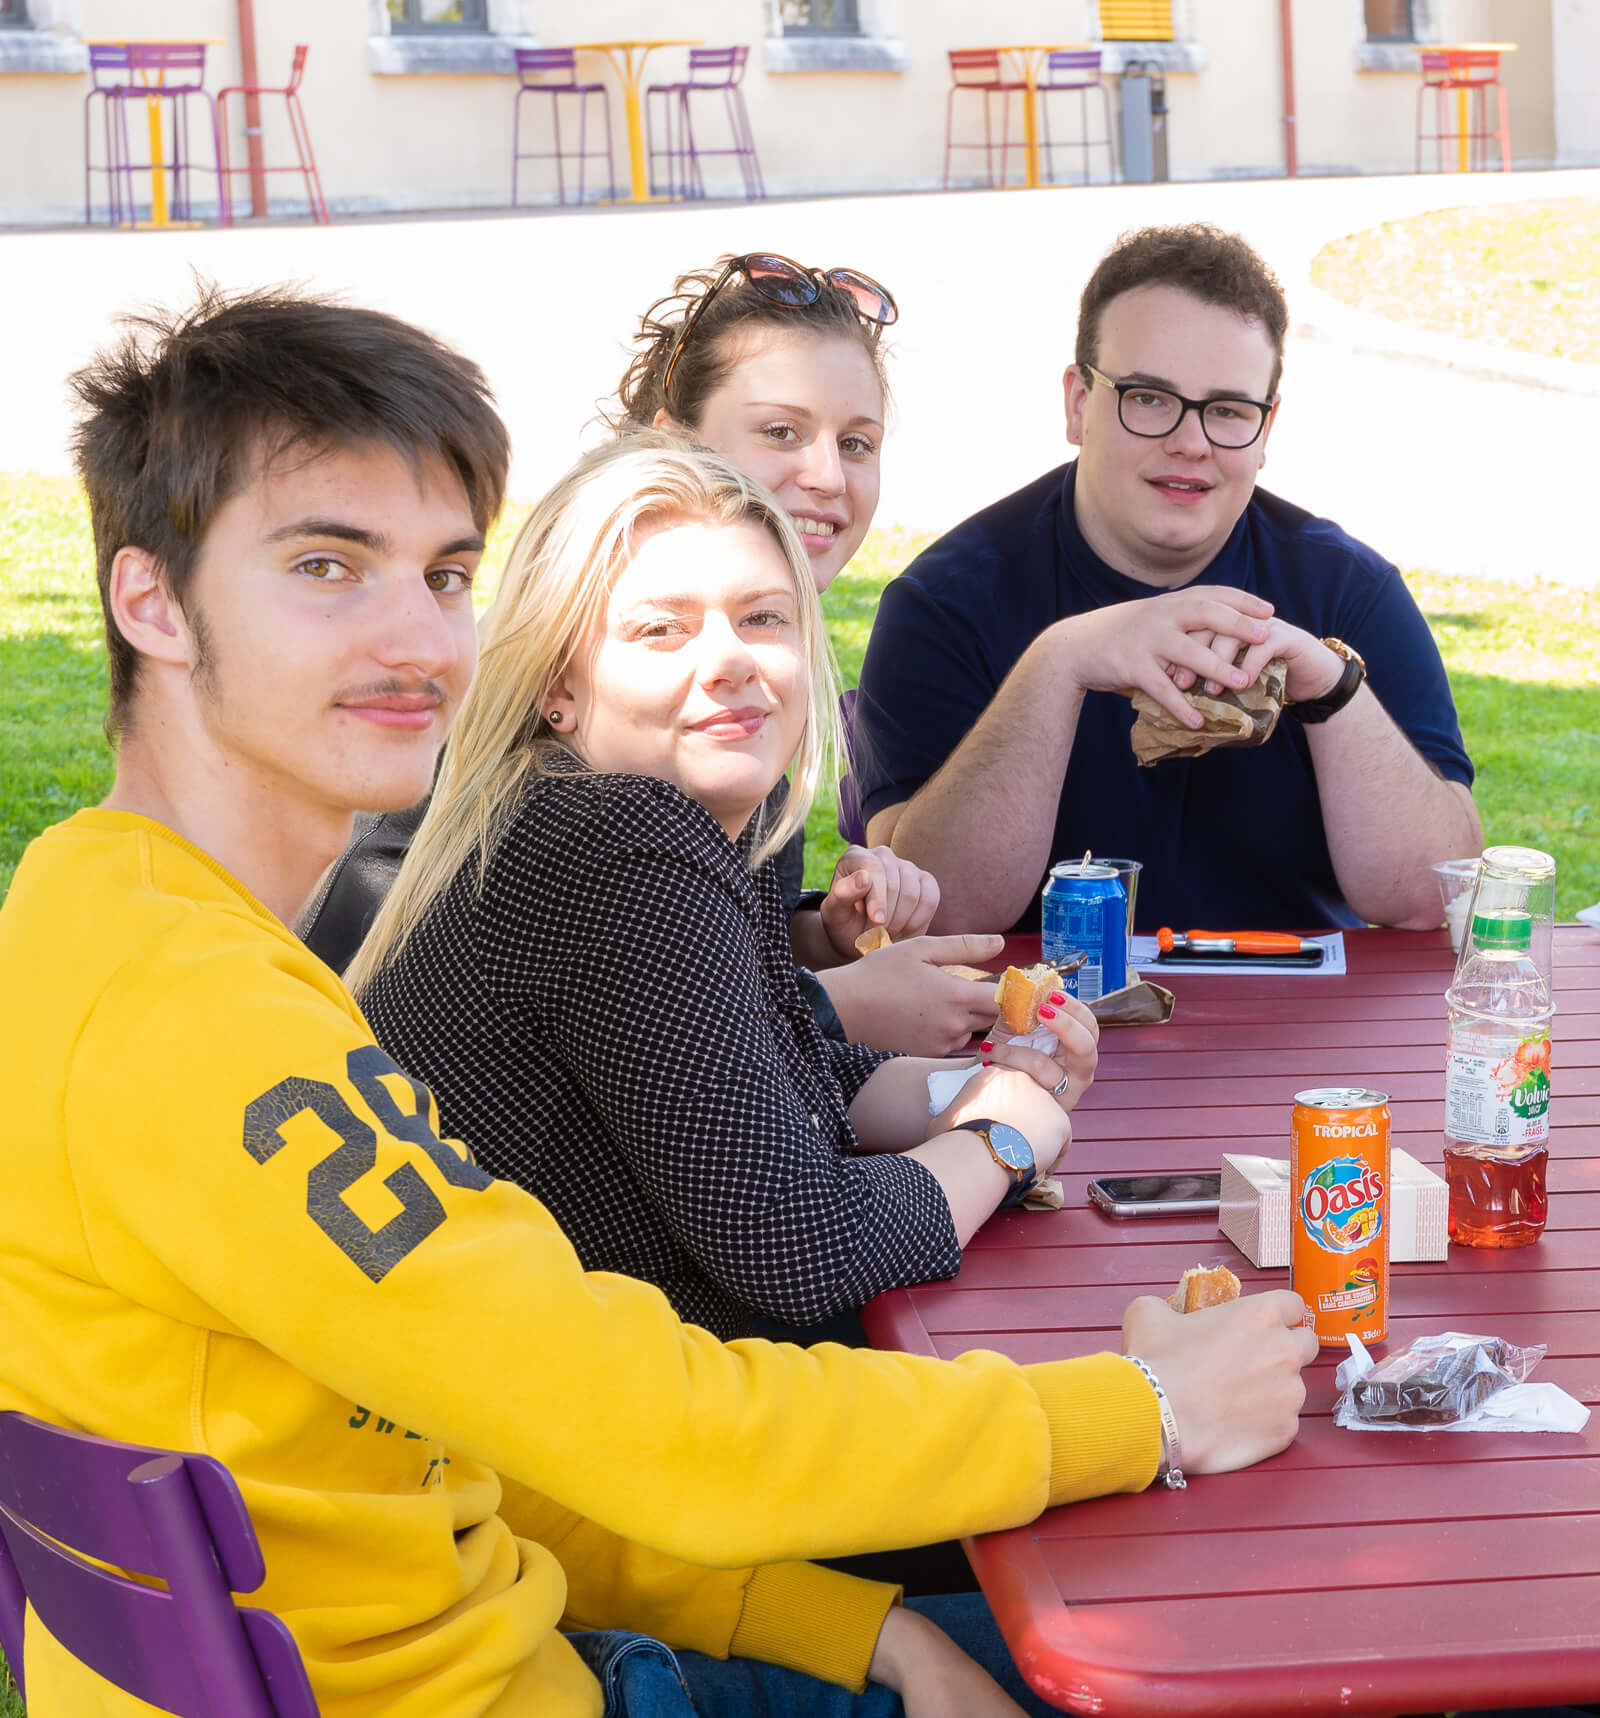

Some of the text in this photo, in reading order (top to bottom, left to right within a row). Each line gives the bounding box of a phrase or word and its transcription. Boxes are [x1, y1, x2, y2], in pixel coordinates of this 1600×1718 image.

[1514, 1084, 1550, 1107] Volvic
[1312, 1123, 1379, 1138] TROPICAL
[1304, 1166, 1384, 1222] Oasis
